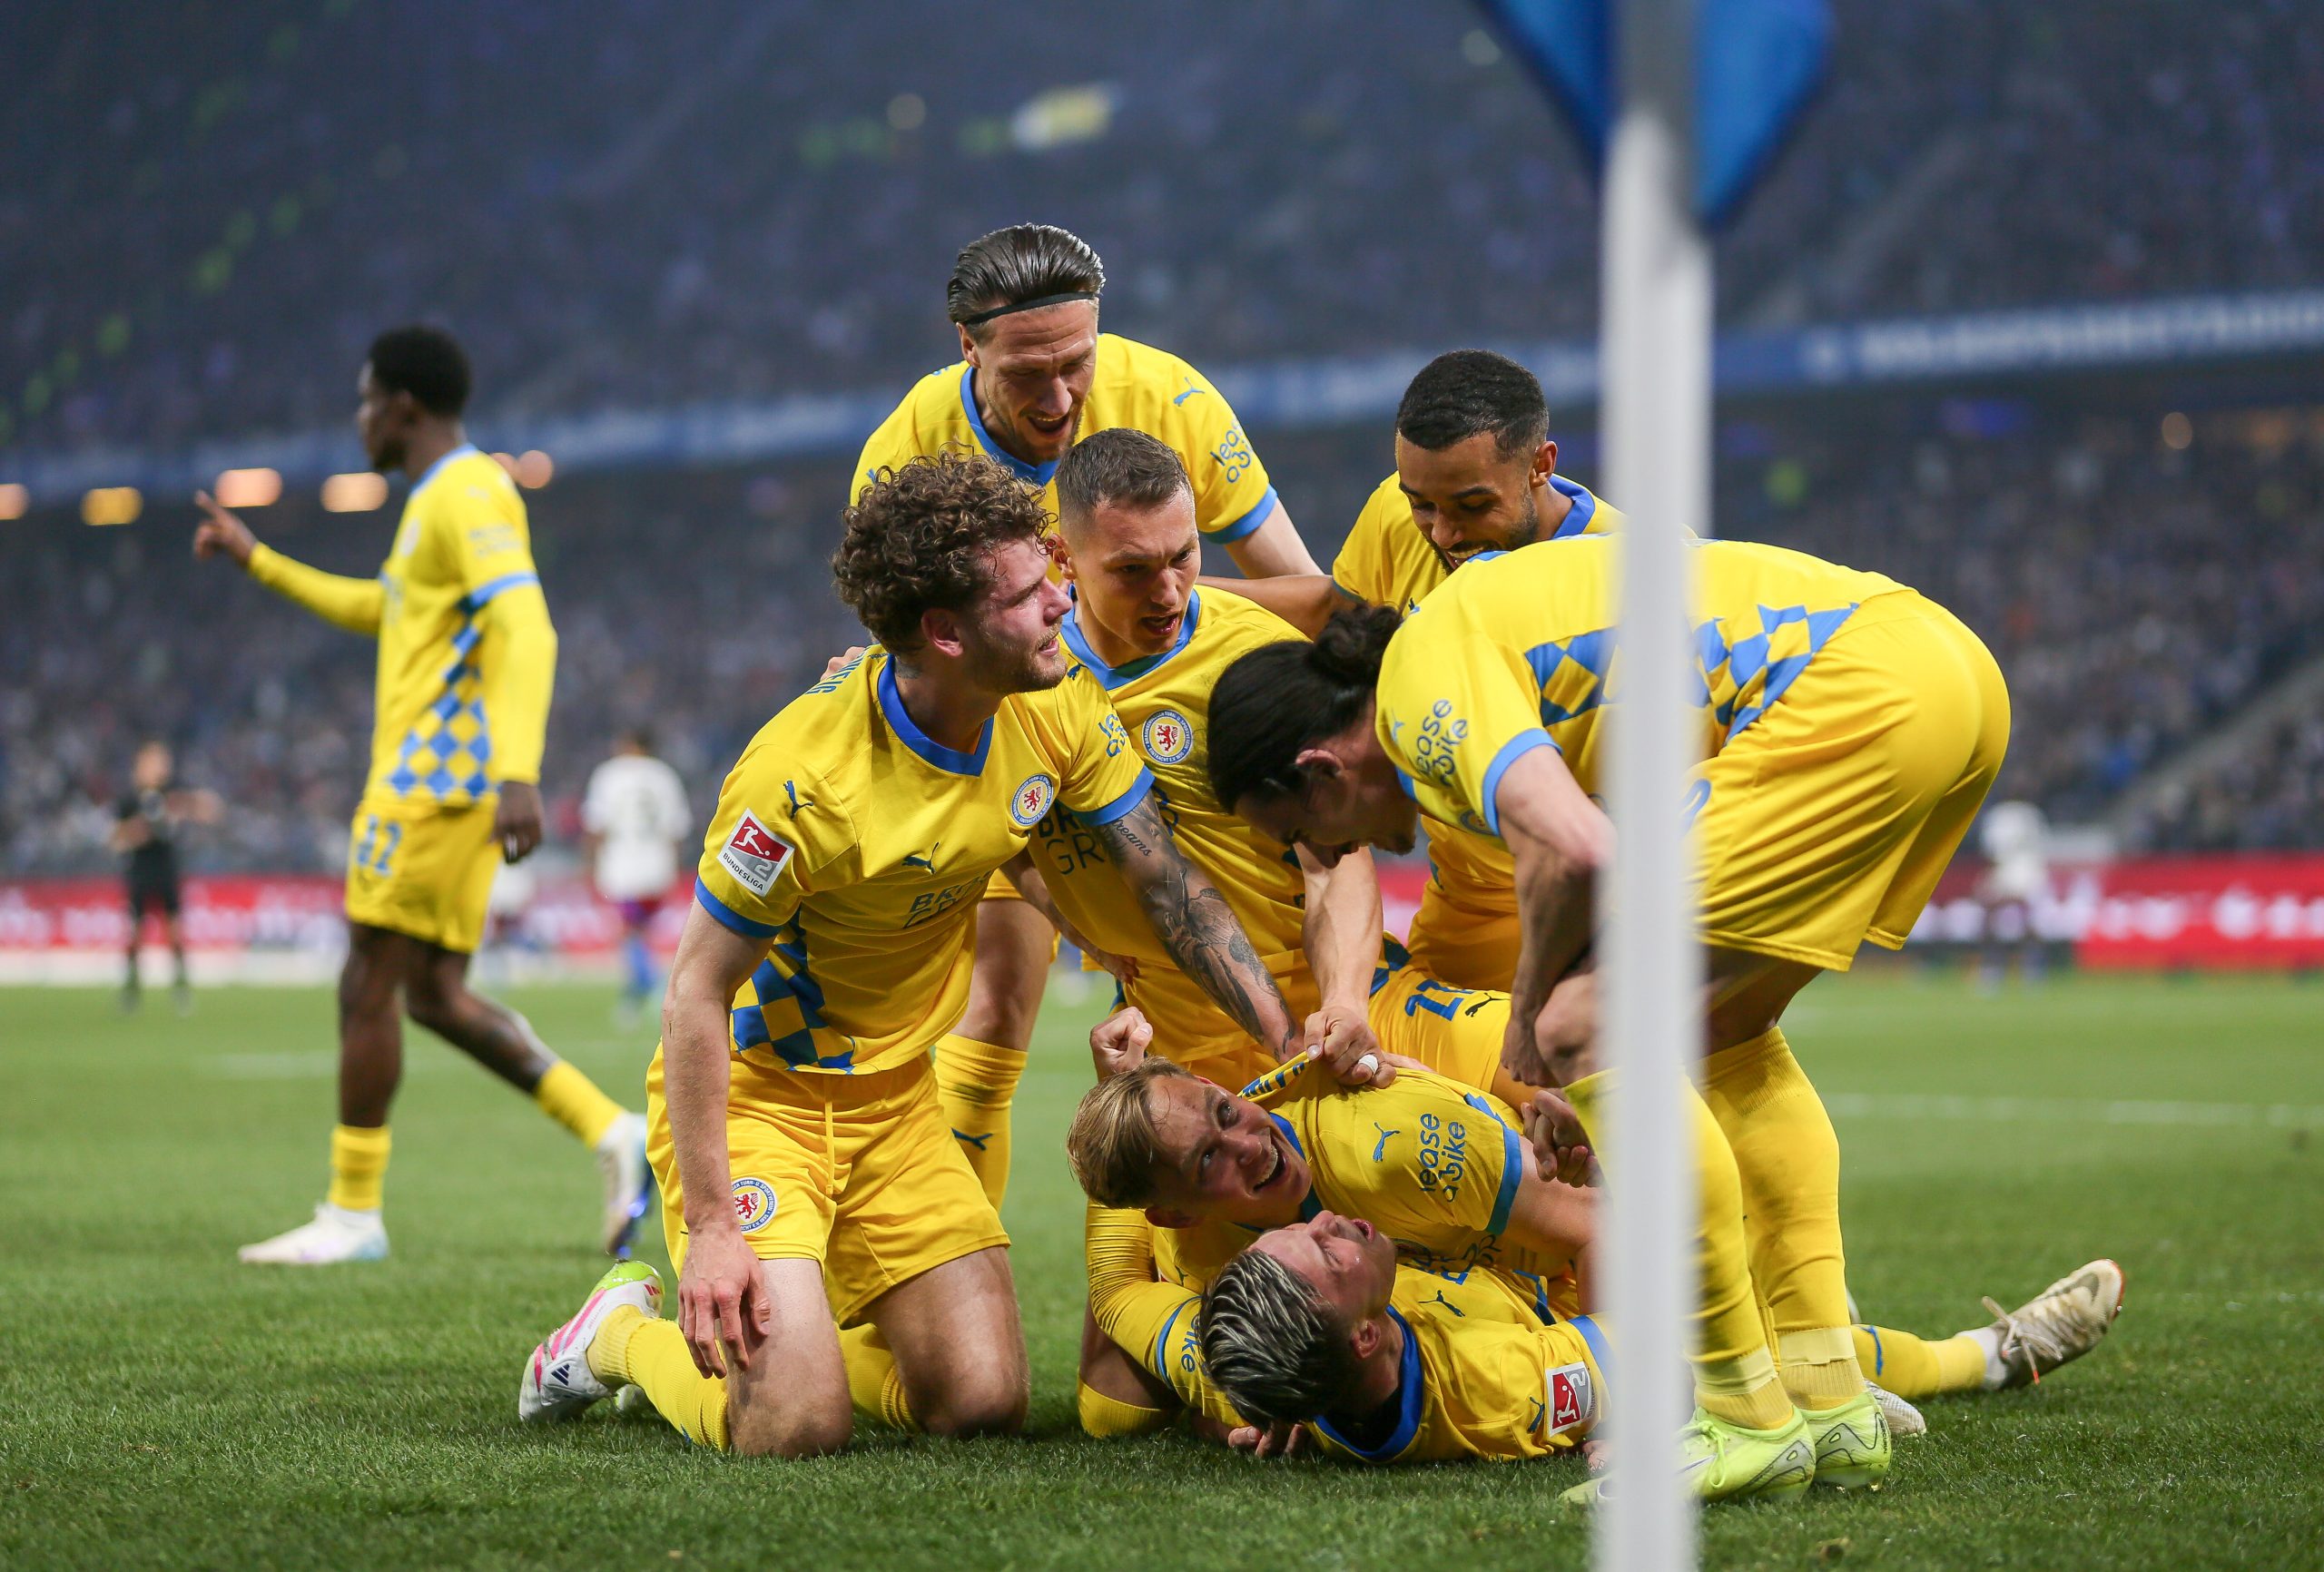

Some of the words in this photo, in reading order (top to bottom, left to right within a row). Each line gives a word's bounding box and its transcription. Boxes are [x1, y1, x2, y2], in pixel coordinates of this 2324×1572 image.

[723, 852, 763, 890] BUNDESLIGA
[753, 857, 773, 878] 2
[1419, 1113, 1441, 1193] lease
[1570, 1371, 1586, 1388] 2
